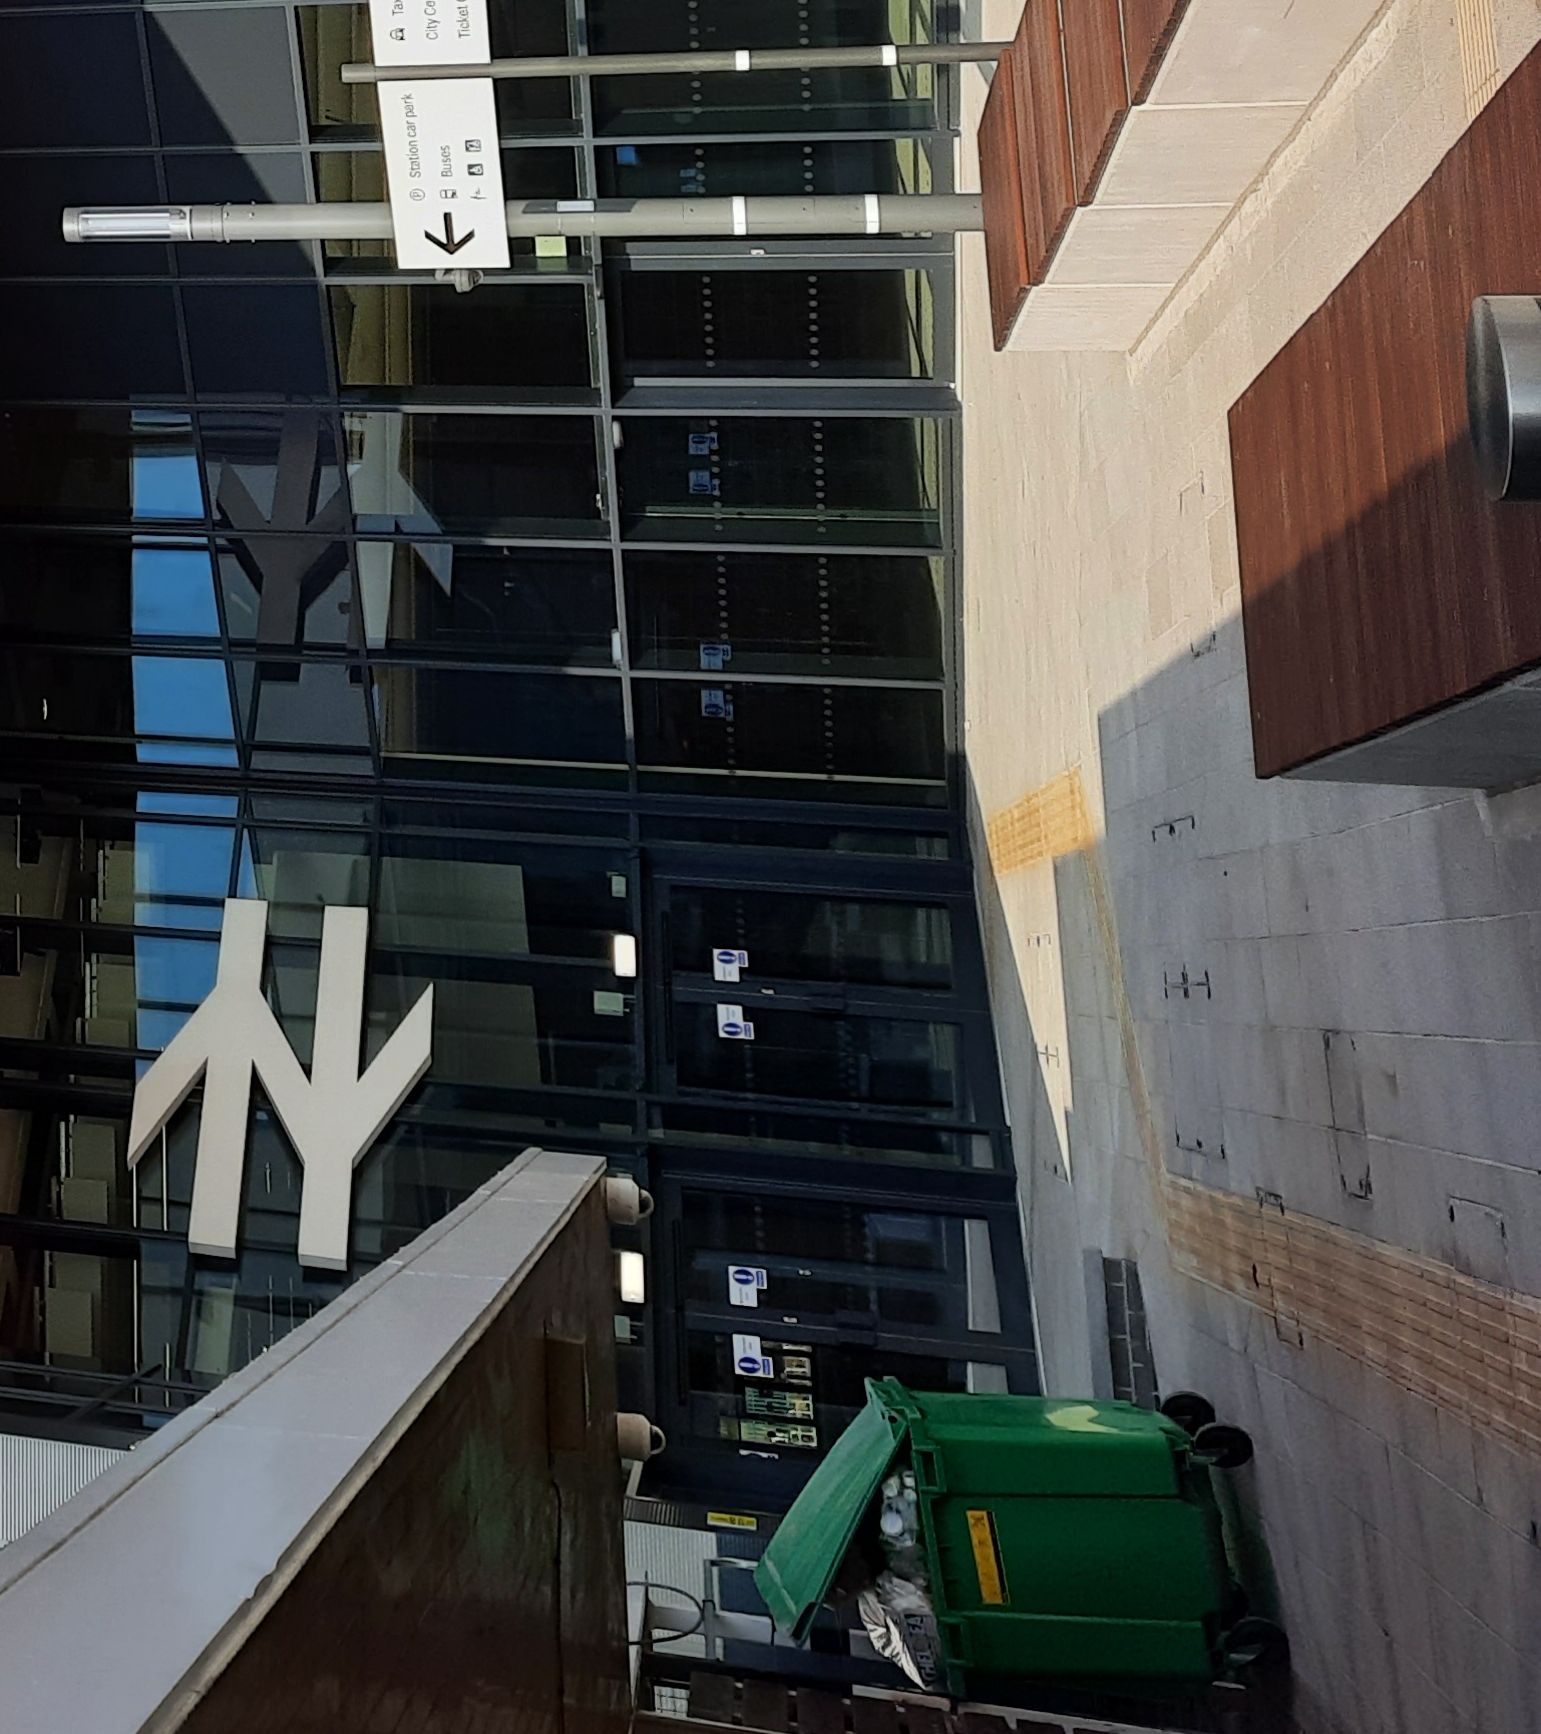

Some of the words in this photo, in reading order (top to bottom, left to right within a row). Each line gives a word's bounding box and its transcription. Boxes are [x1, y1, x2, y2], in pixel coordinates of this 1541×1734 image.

[424, 18, 441, 40] City
[455, 5, 471, 39] Ticket
[401, 93, 418, 118] park
[405, 120, 417, 137] car
[405, 140, 422, 178] Station
[440, 145, 453, 178] Buses
[907, 1615, 936, 1681] CHELEA
